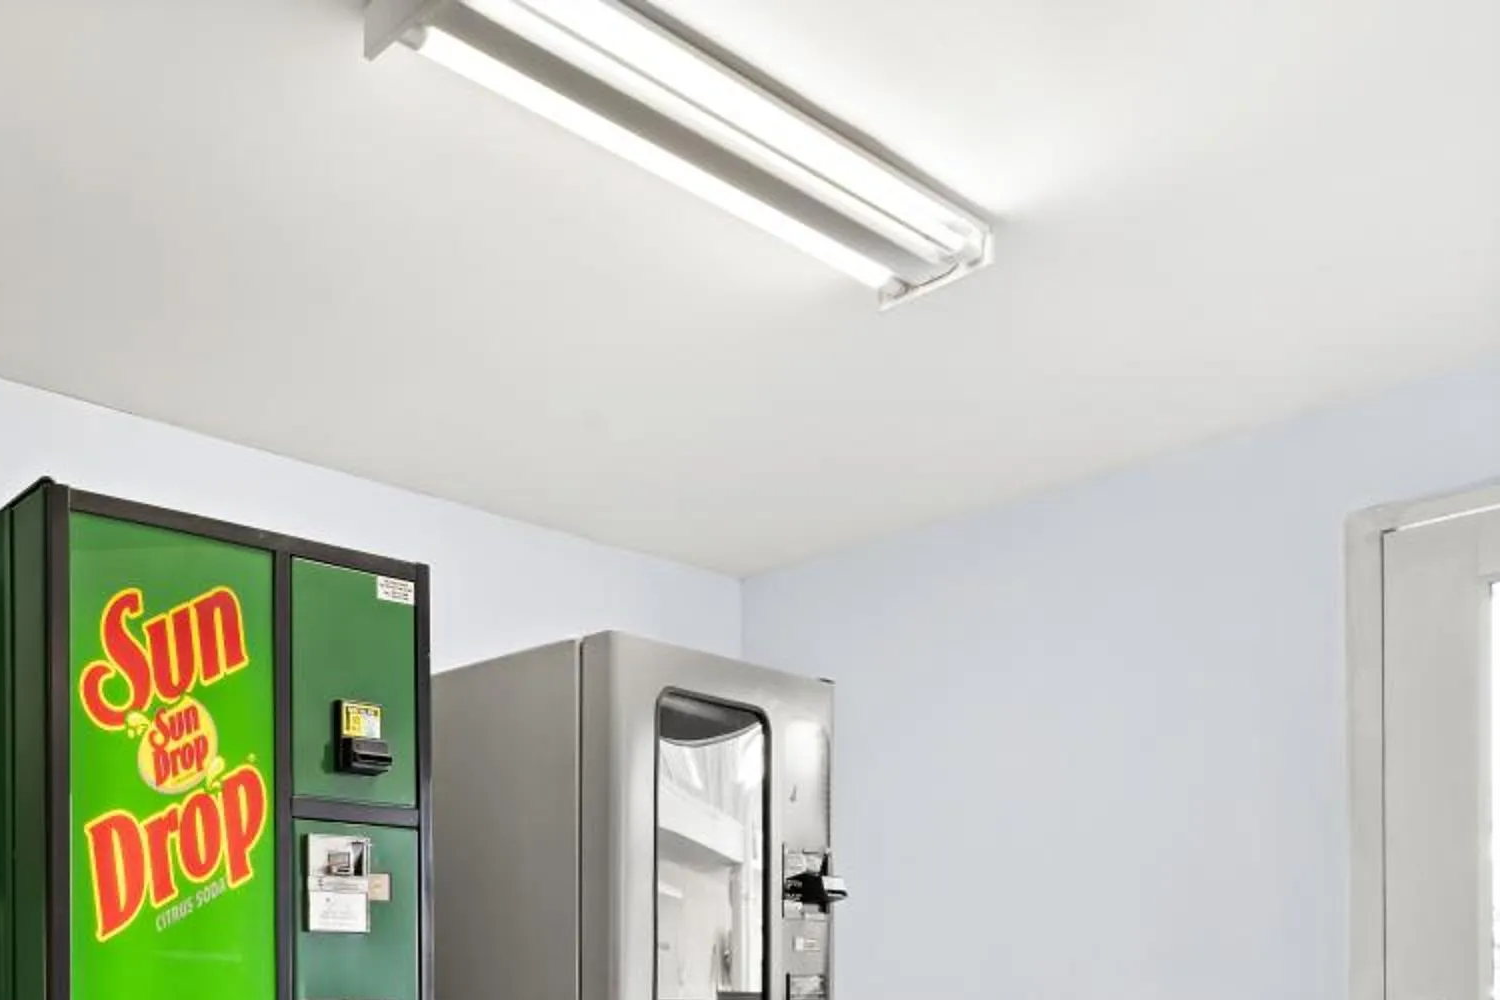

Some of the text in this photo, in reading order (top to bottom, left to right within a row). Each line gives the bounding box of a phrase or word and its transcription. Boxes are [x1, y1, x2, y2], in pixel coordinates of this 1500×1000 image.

[79, 585, 249, 731] Sun
[148, 705, 201, 749] Sun
[152, 734, 210, 787] Drop
[84, 762, 269, 942] Drop
[155, 877, 227, 933] CITRUS SODA
